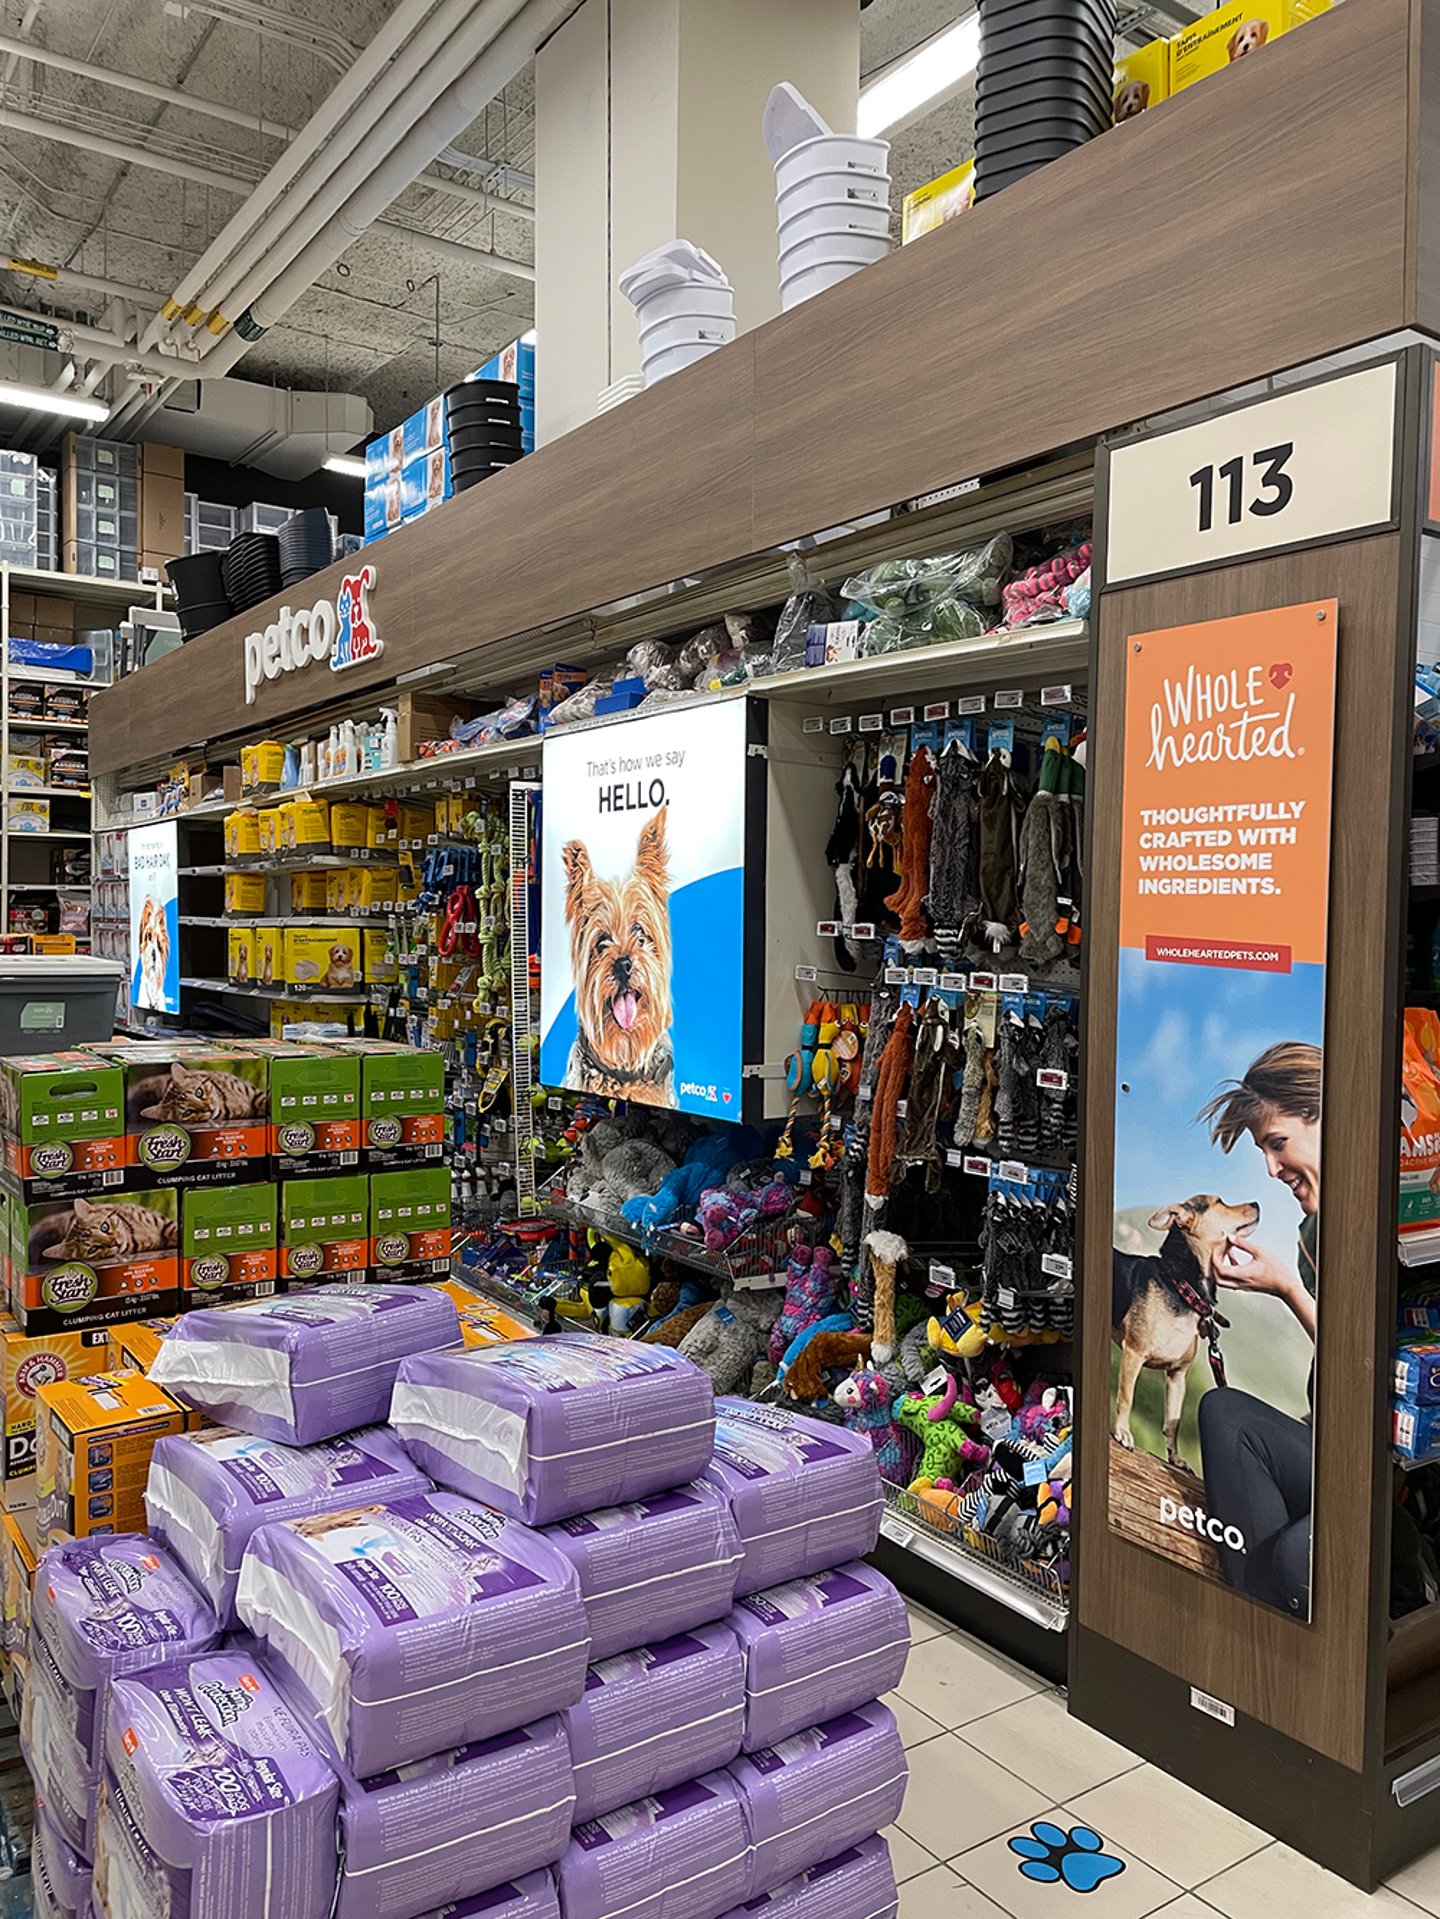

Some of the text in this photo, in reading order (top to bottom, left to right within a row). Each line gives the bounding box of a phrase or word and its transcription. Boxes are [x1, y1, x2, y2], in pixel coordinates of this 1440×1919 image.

[1189, 442, 1293, 532] 113
[245, 599, 335, 704] petco
[1163, 664, 1264, 728] WHOLE
[586, 750, 686, 777] That's how we say
[599, 778, 670, 813] HELLO.
[1140, 800, 1306, 826] THOUGHTFULLY
[1139, 827, 1296, 849] CRAFTED WITH
[1139, 852, 1272, 872] WHOLESOME
[1138, 877, 1281, 895] INGREDIENTS.
[1156, 947, 1279, 961] WHOLEHEARTEDPETS.COM
[680, 1082, 706, 1097] petco
[145, 1135, 185, 1151] Fresh
[37, 1149, 68, 1162] Fresh
[157, 1171, 236, 1184] CLUMPING CAT LITTER
[50, 1274, 93, 1290] Fresh
[63, 1307, 147, 1326] CLUMPING CAT LITTER
[1160, 1496, 1244, 1550] petco
[193, 1713, 213, 1740] LEAK
[211, 1767, 241, 1792] 100
